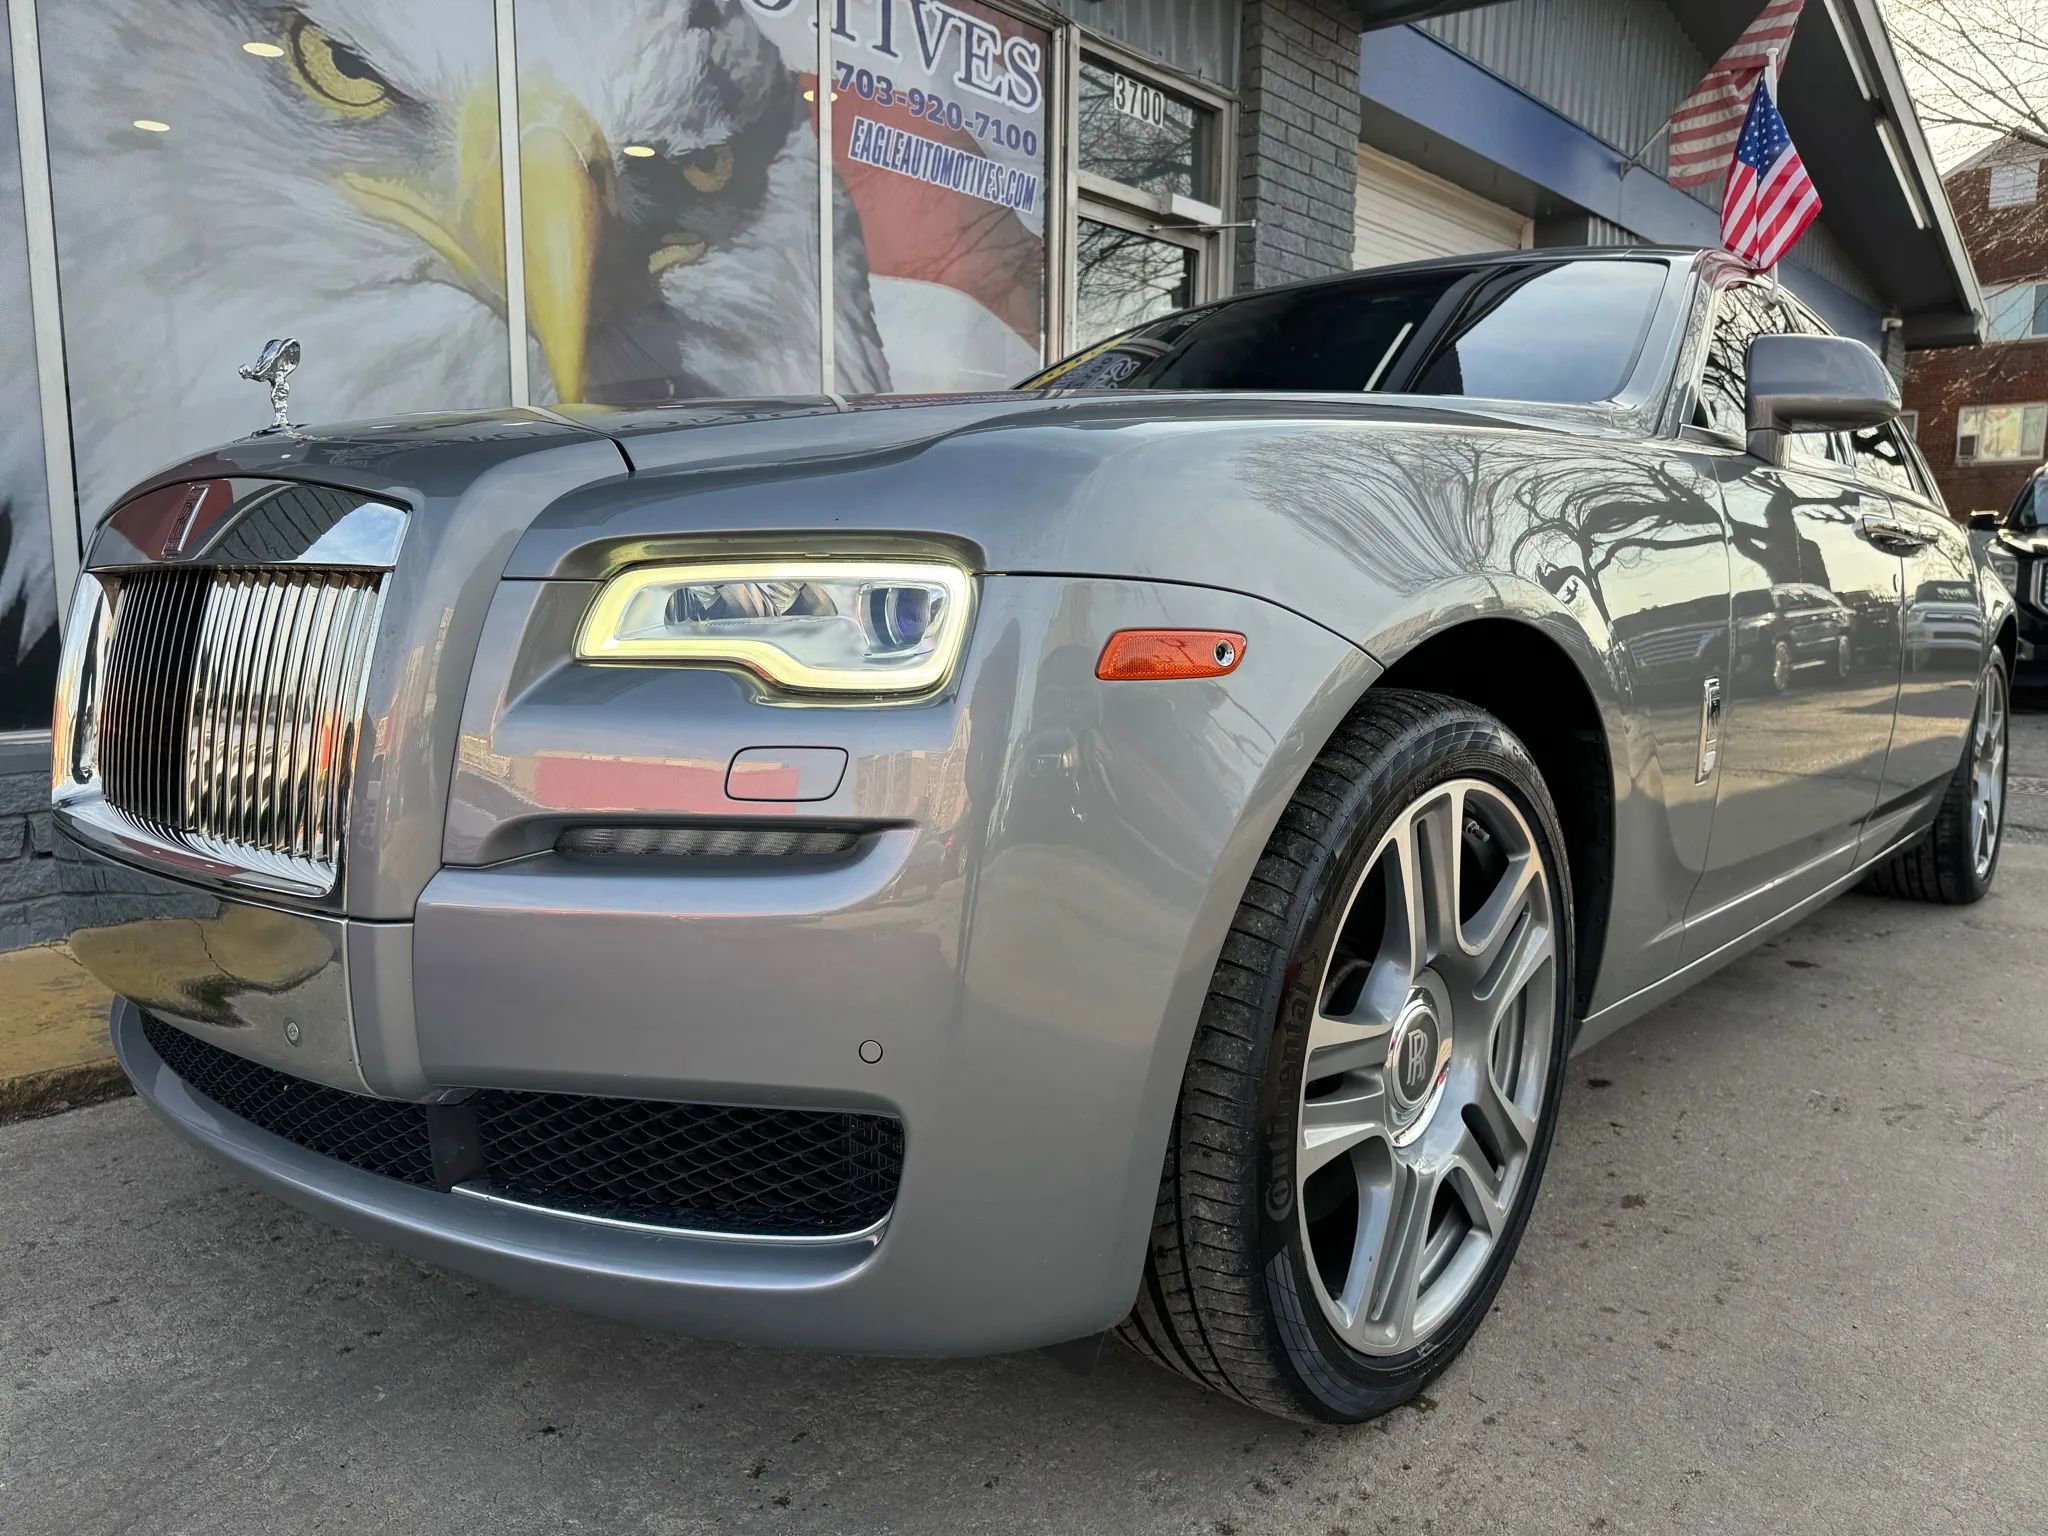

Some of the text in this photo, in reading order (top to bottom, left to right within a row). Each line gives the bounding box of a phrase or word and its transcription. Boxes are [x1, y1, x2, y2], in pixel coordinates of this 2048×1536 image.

[749, 0, 1041, 109] IVES
[1116, 75, 1161, 126] 3700
[835, 60, 1037, 157] 703-920-7100
[849, 118, 1037, 213] EAGLEAUTOMOTIVES.COM
[1406, 1028, 1429, 1087] RR
